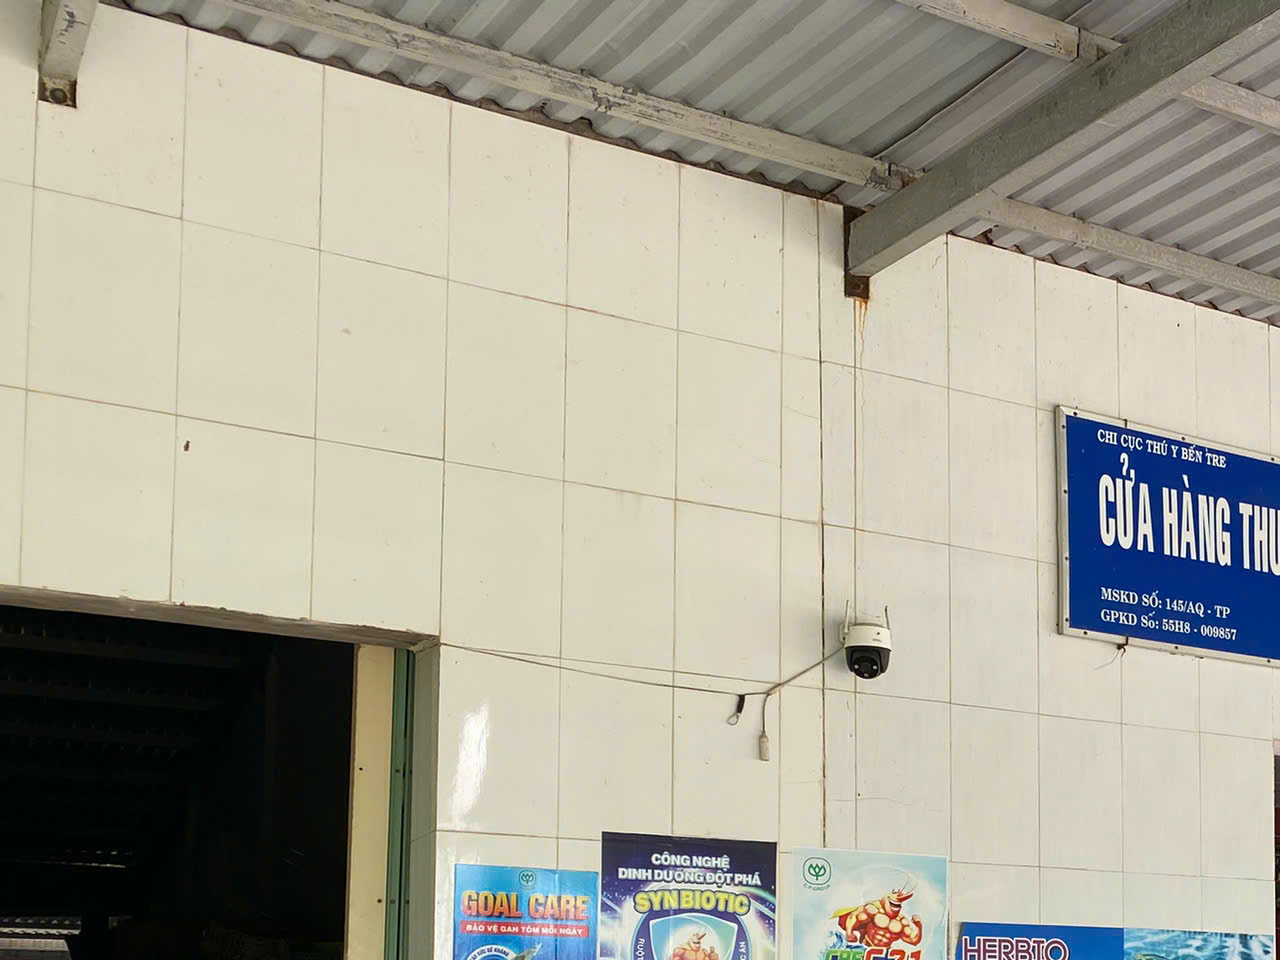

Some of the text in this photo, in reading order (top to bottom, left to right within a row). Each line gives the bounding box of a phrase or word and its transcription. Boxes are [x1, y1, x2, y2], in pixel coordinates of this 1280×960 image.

[1097, 429, 1227, 468] CHI CỤC THÚ Y BẾN TRE
[1099, 452, 1154, 552] CỬA
[1162, 474, 1231, 567] HÀNG
[1101, 587, 1231, 619] MSKD SỐ: 145/AQ TP
[1101, 609, 1237, 641] GPKD Số: 55H8 009857
[651, 851, 730, 870] CÔNG NGHỆ
[618, 867, 652, 881] DINH
[705, 872, 733, 888] ĐỘT
[734, 871, 762, 886] PHÁ
[461, 889, 589, 921] GOAL CARE
[634, 889, 750, 916] SYNBIOTIC
[466, 922, 484, 931] BẢO
[521, 924, 539, 934] TÔM
